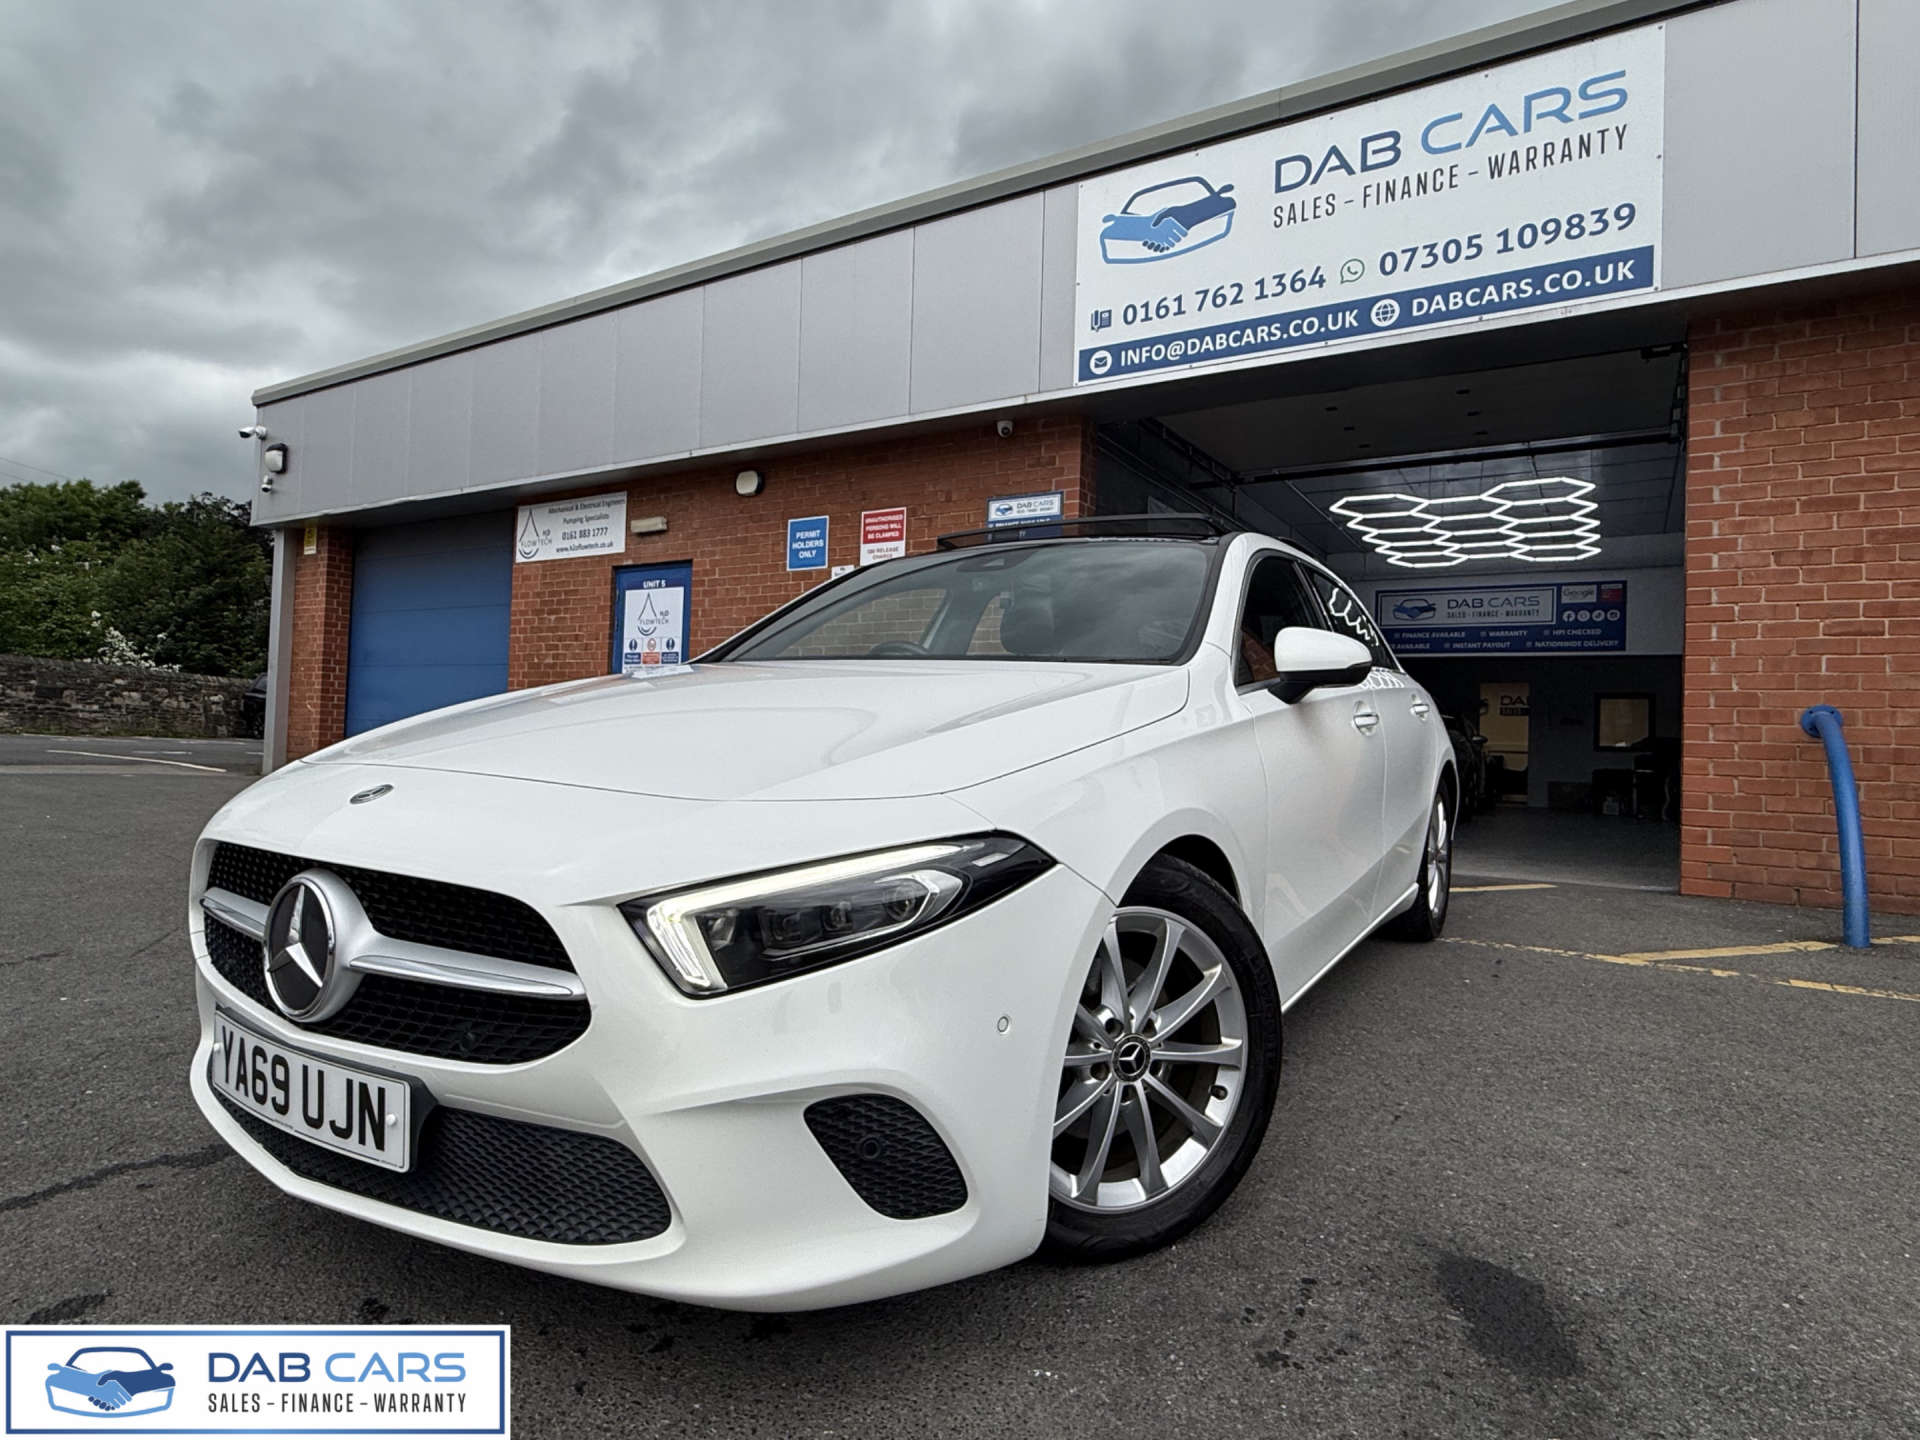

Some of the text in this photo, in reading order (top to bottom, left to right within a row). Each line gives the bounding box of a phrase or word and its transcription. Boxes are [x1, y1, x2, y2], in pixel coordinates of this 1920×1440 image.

[1275, 69, 1628, 193] DAB CARS
[1273, 193, 1337, 228] SALES
[1363, 164, 1460, 208] FINANCE
[1488, 124, 1628, 180] WARRANTY
[1379, 203, 1636, 276] 07305 109839
[1411, 259, 1635, 317] DABCARS.CO.UK
[1122, 266, 1326, 326] 0161 762 1364
[1121, 309, 1359, 367] INFO@DABCARS.CO.UK
[796, 530, 821, 539] PERMIT
[792, 539, 824, 550] HOLDERS
[798, 550, 817, 559] ONLY
[643, 579, 660, 589] UNIT
[1563, 588, 1594, 598] Google
[1447, 596, 1540, 609] DAB CARS
[1488, 630, 1528, 638] WARRANTY
[1481, 641, 1511, 649] PAYOUT
[1582, 639, 1619, 647] DELIVERY
[1500, 695, 1528, 706] DA
[222, 1025, 386, 1152] YA69 UJN
